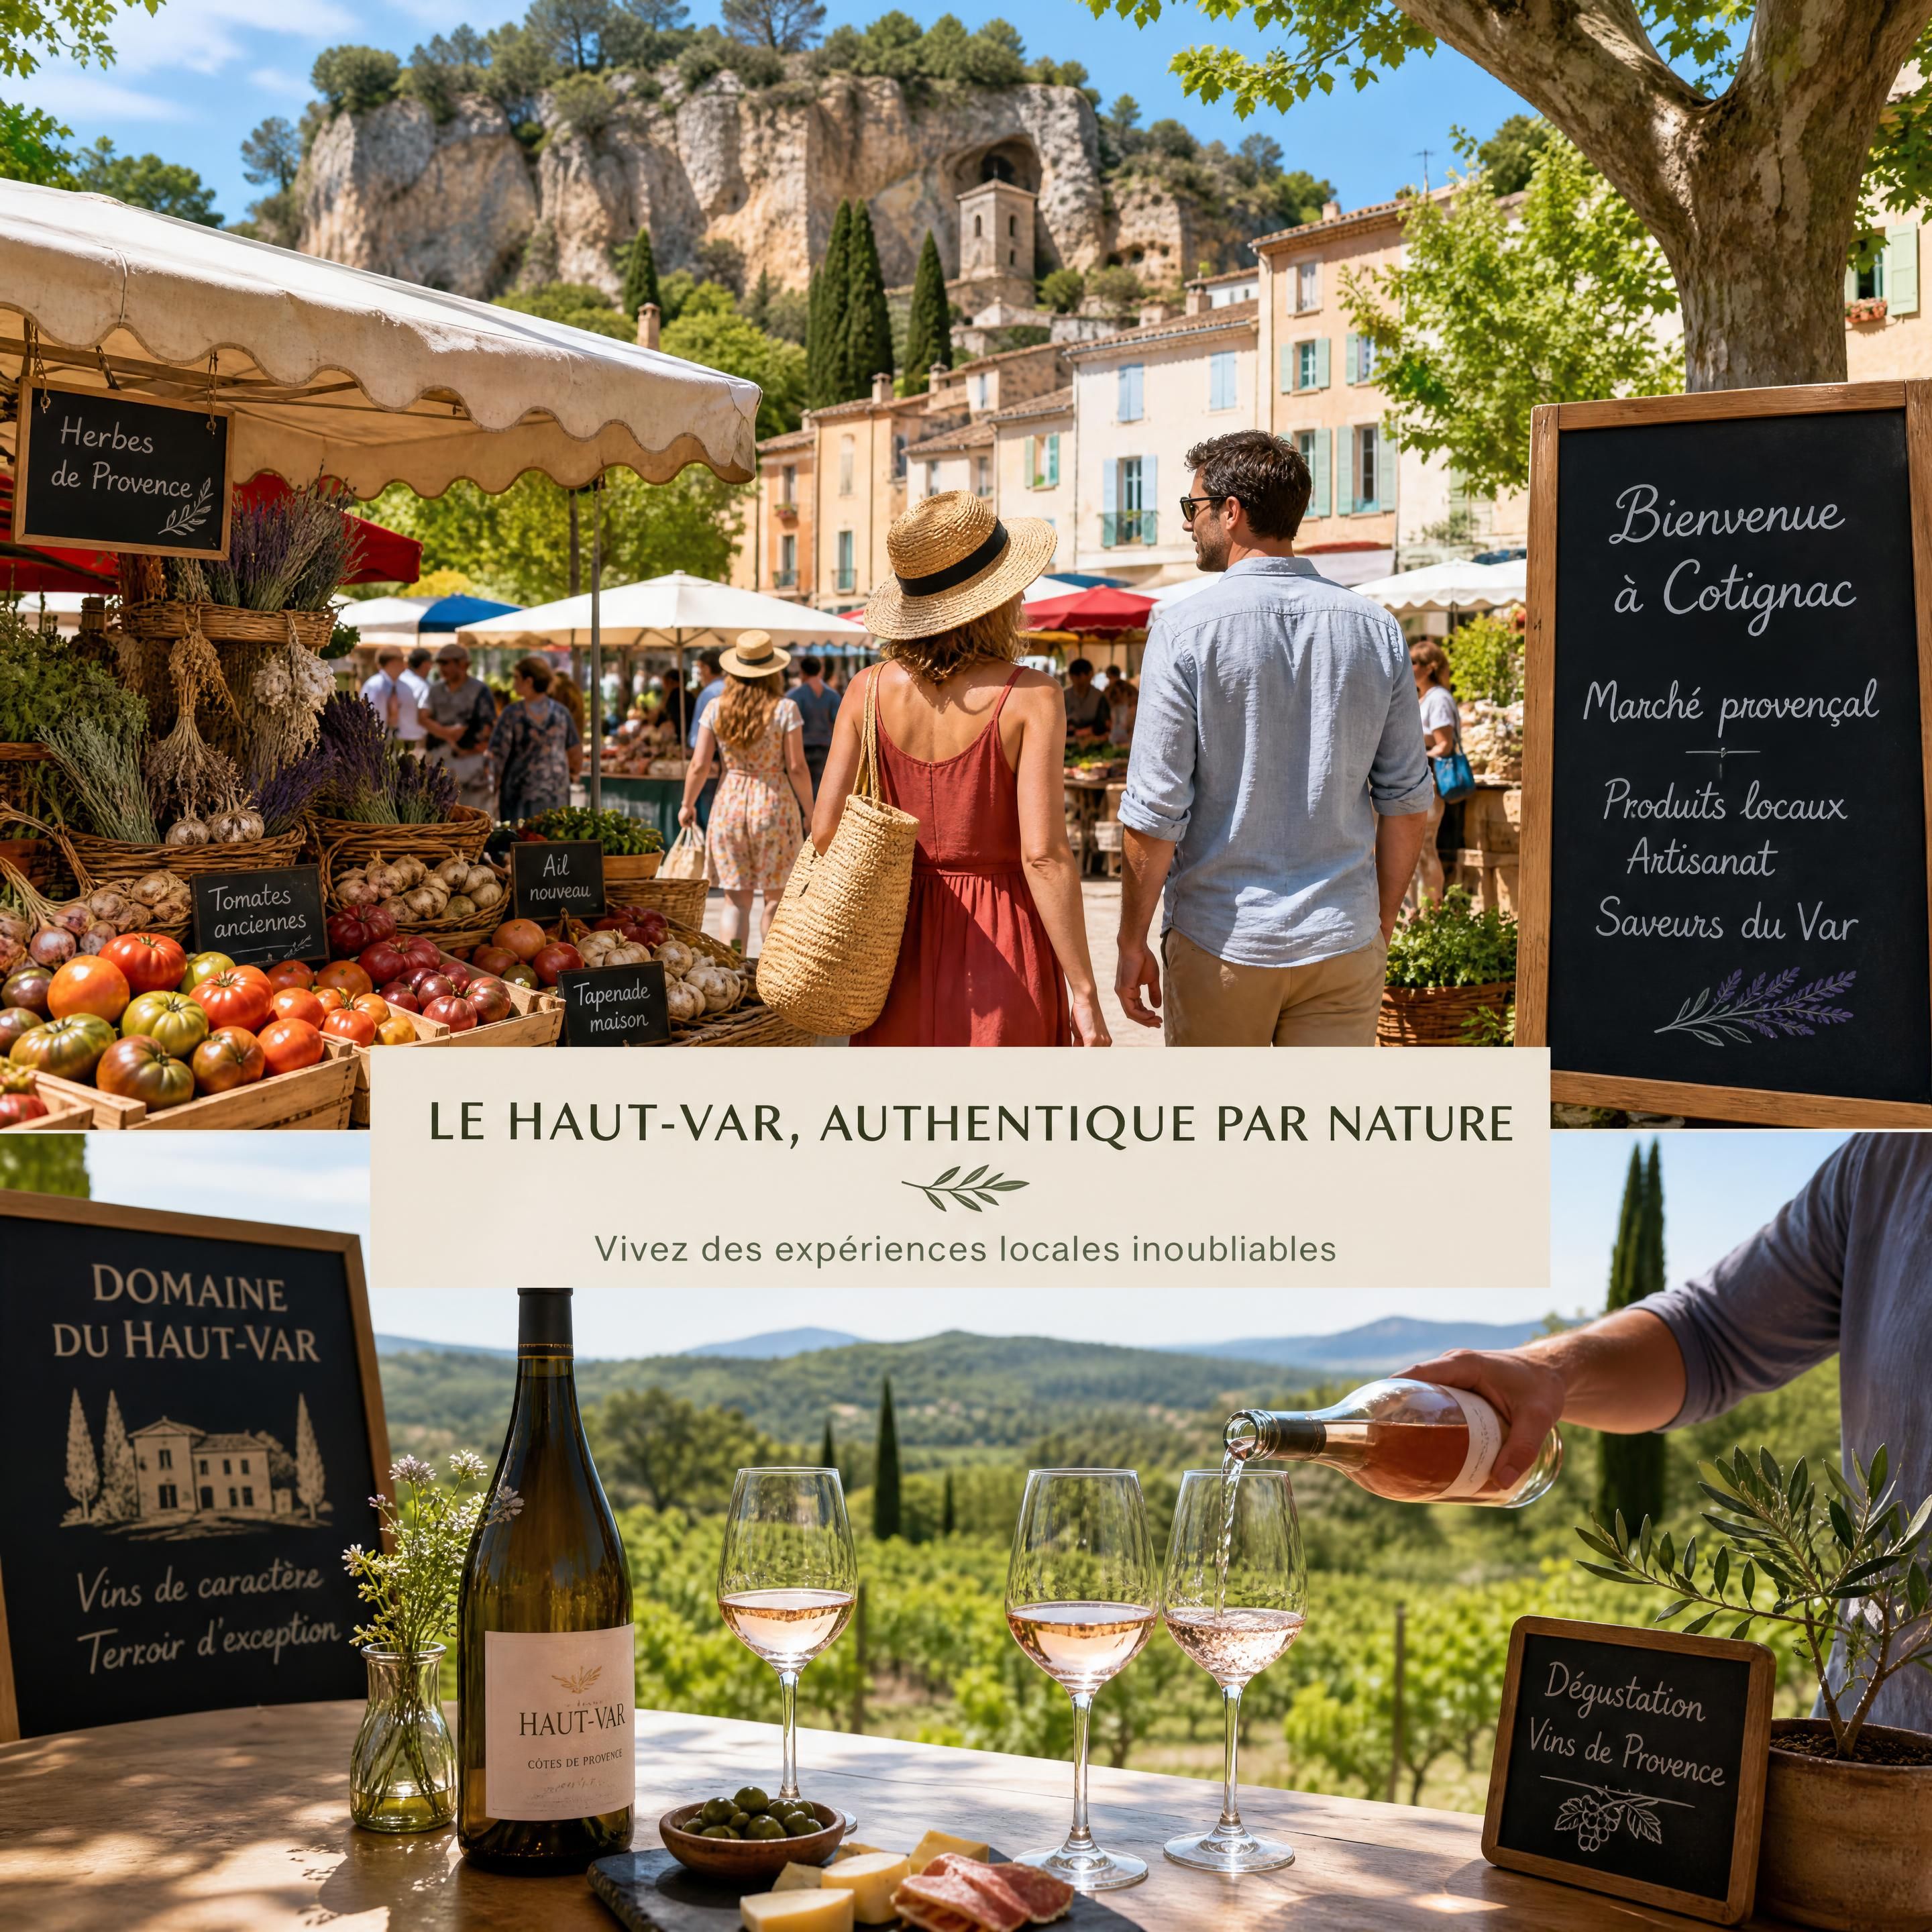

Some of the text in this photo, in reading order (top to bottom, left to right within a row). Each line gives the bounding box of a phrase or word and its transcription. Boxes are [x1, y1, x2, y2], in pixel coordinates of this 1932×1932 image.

[60, 415, 154, 453] Herbes
[51, 459, 193, 498] de Provence
[1608, 484, 1845, 545] Bienvenue
[1614, 558, 1857, 637] à Cotignac
[1582, 678, 1880, 739] Marché provençal
[1603, 777, 1848, 820] Produits locaux
[543, 853, 570, 877] Ail
[1626, 837, 1779, 877] Artisanat
[207, 883, 291, 912] Tomates
[530, 885, 591, 901] nouveau
[214, 914, 307, 938] anciennes
[1595, 896, 1860, 941] Saveurs du Var
[573, 978, 651, 1012] Tapenade
[590, 1011, 649, 1032] maison
[92, 1264, 288, 1311] DOMAINE
[53, 1320, 319, 1362] DU HAUT-VAR
[77, 1558, 323, 1613] Vins de caractère
[76, 1612, 341, 1674] Terroir d'exception
[1544, 1661, 1706, 1722] Dégustation
[519, 1703, 626, 1736] HAUT-VAR
[528, 1748, 623, 1770] CÔTES DE PROVENCE
[1531, 1717, 1725, 1786] Vins de Provence
